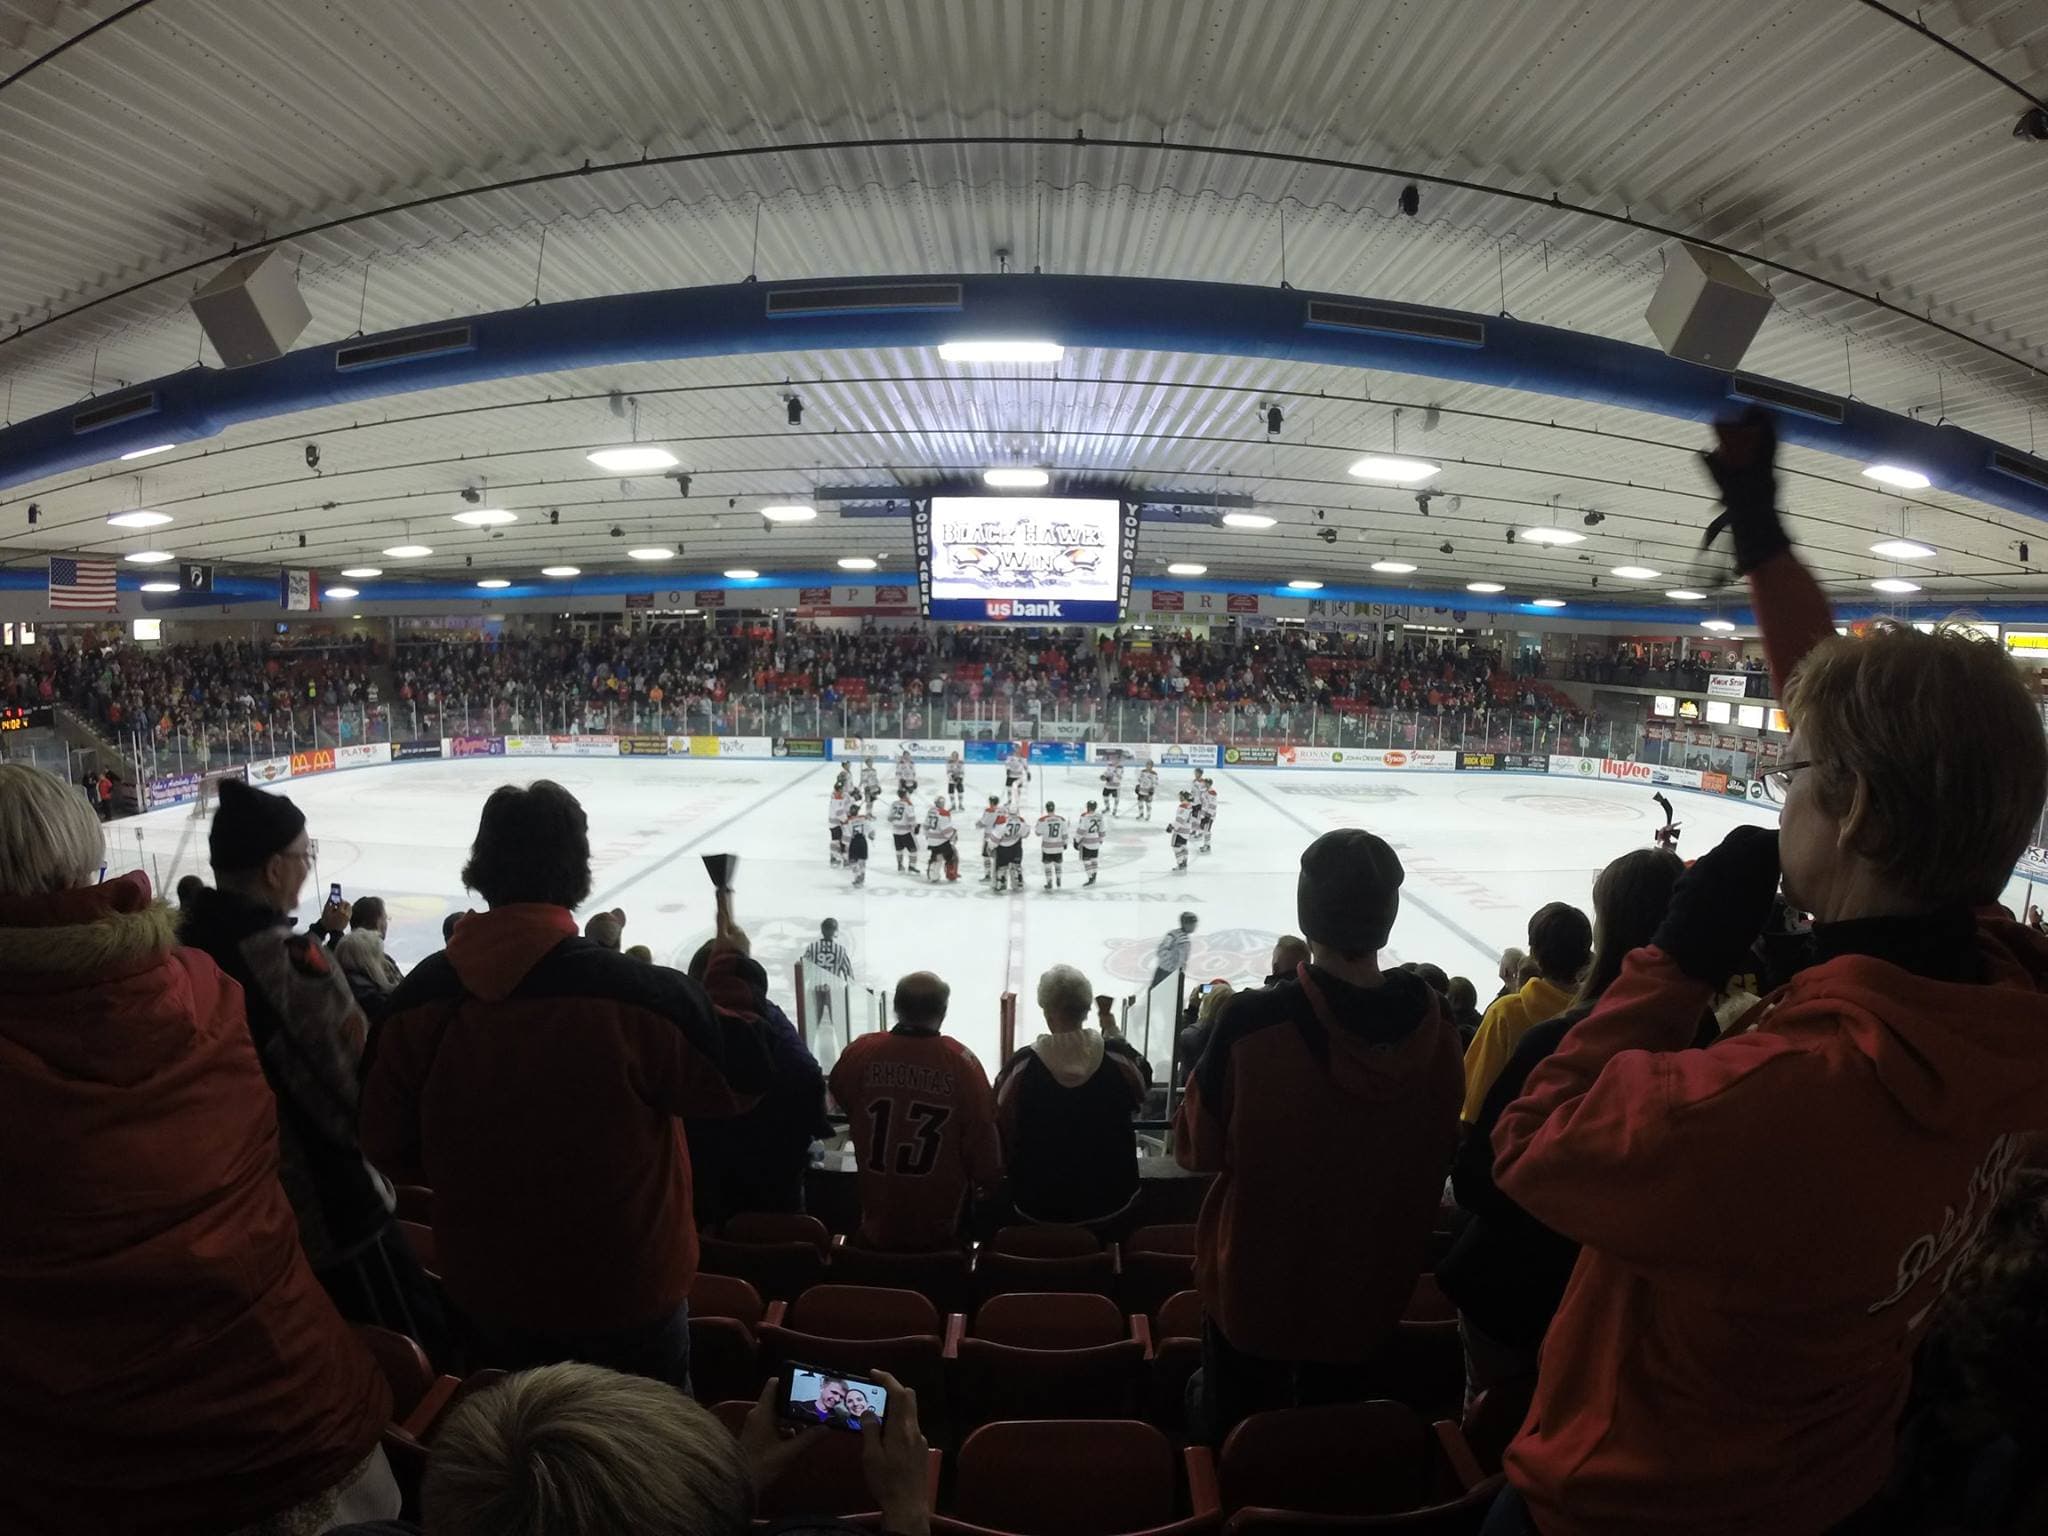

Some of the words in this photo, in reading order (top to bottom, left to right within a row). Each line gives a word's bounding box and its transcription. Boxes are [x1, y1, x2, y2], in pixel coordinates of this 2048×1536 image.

[915, 499, 929, 556] YOUNG
[1122, 502, 1139, 560] YOUNG
[847, 588, 858, 601] P
[920, 561, 930, 615] ARENA
[1119, 564, 1132, 618] ARENA
[1200, 595, 1212, 608] R
[1047, 822, 1061, 839] 18
[817, 952, 836, 967] 92
[866, 1097, 953, 1177] 13
